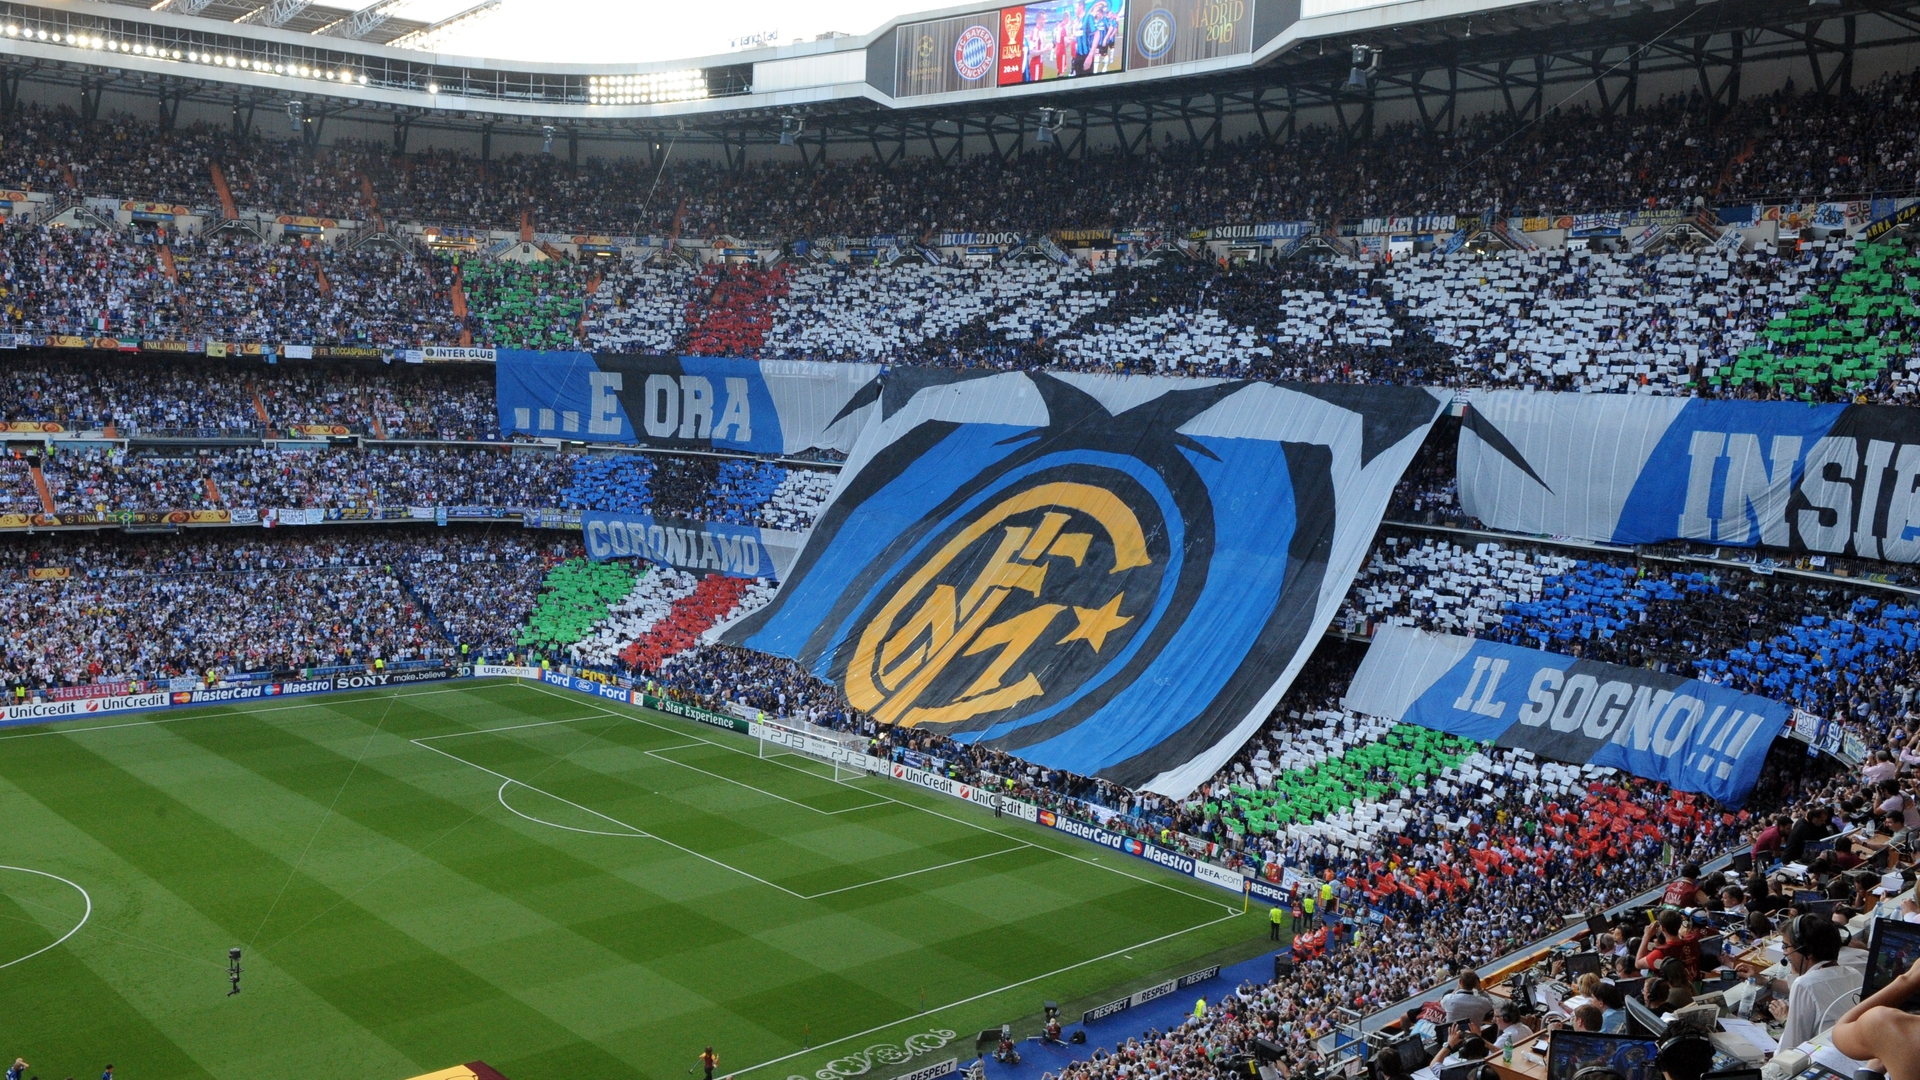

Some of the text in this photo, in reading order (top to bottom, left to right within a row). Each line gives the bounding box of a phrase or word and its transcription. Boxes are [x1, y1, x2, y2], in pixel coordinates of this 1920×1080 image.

[958, 28, 992, 52] FC BAYERN
[1206, 22, 1232, 43] 2010
[1215, 224, 1299, 238] SQUILIBRATI
[1425, 215, 1456, 230] 1988
[943, 232, 1021, 245] BULL DOGS
[436, 349, 494, 359] INTER CLUB
[760, 361, 818, 375] RIANZA
[643, 374, 752, 442] ORA
[587, 520, 759, 575] CORONIAMO
[283, 680, 329, 694] Maestro
[337, 667, 471, 689] SONY make.believe 3D
[545, 671, 570, 687] Ford
[53, 681, 145, 699] Hauzenbeg
[191, 684, 261, 703] MasterCard
[599, 685, 626, 700] Ford
[9, 701, 75, 719] UniCredit
[102, 694, 164, 711] UniCredit
[665, 701, 683, 715] Star
[685, 707, 734, 729] Experience
[1452, 656, 1765, 780] IL SOGNO!!!
[906, 768, 953, 793] UniCredit
[972, 791, 1021, 816] UniCedit
[1055, 815, 1122, 849] MasterCard
[1143, 845, 1193, 873] Maestro
[1251, 883, 1289, 903] RESPECT
[1186, 967, 1218, 986] RESPECT
[1141, 982, 1173, 1001] RESPECT
[1093, 999, 1128, 1020] RESPECT
